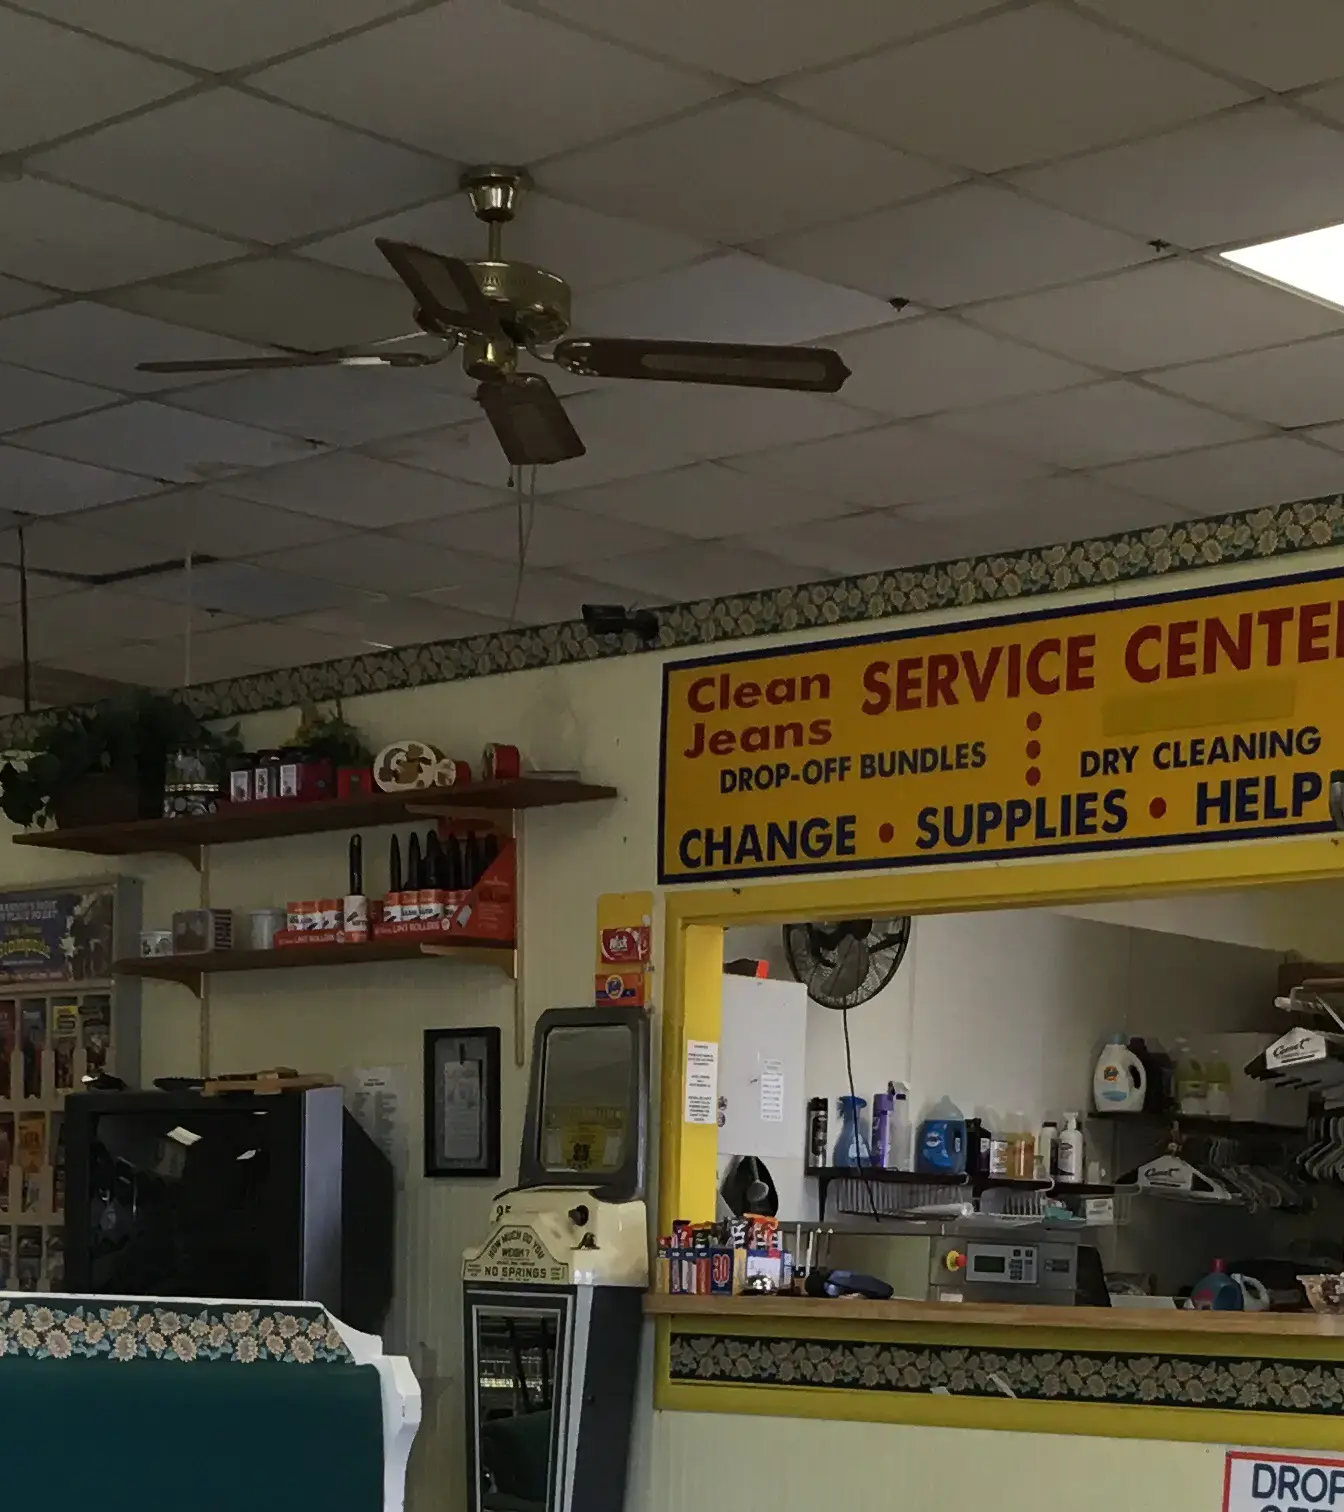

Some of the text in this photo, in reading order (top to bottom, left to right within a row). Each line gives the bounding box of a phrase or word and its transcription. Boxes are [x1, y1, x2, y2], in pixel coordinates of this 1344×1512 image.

[687, 671, 831, 714] Clean
[861, 634, 1096, 716] SERVICE
[683, 718, 833, 759] Jeans
[1080, 726, 1322, 778] DRY CLEANING
[720, 742, 987, 793] DROP-OFF BUNDLES
[679, 815, 858, 869] CHANGE
[915, 789, 1128, 850] SUPPLIES
[485, 1266, 547, 1278] NO SPRINGS
